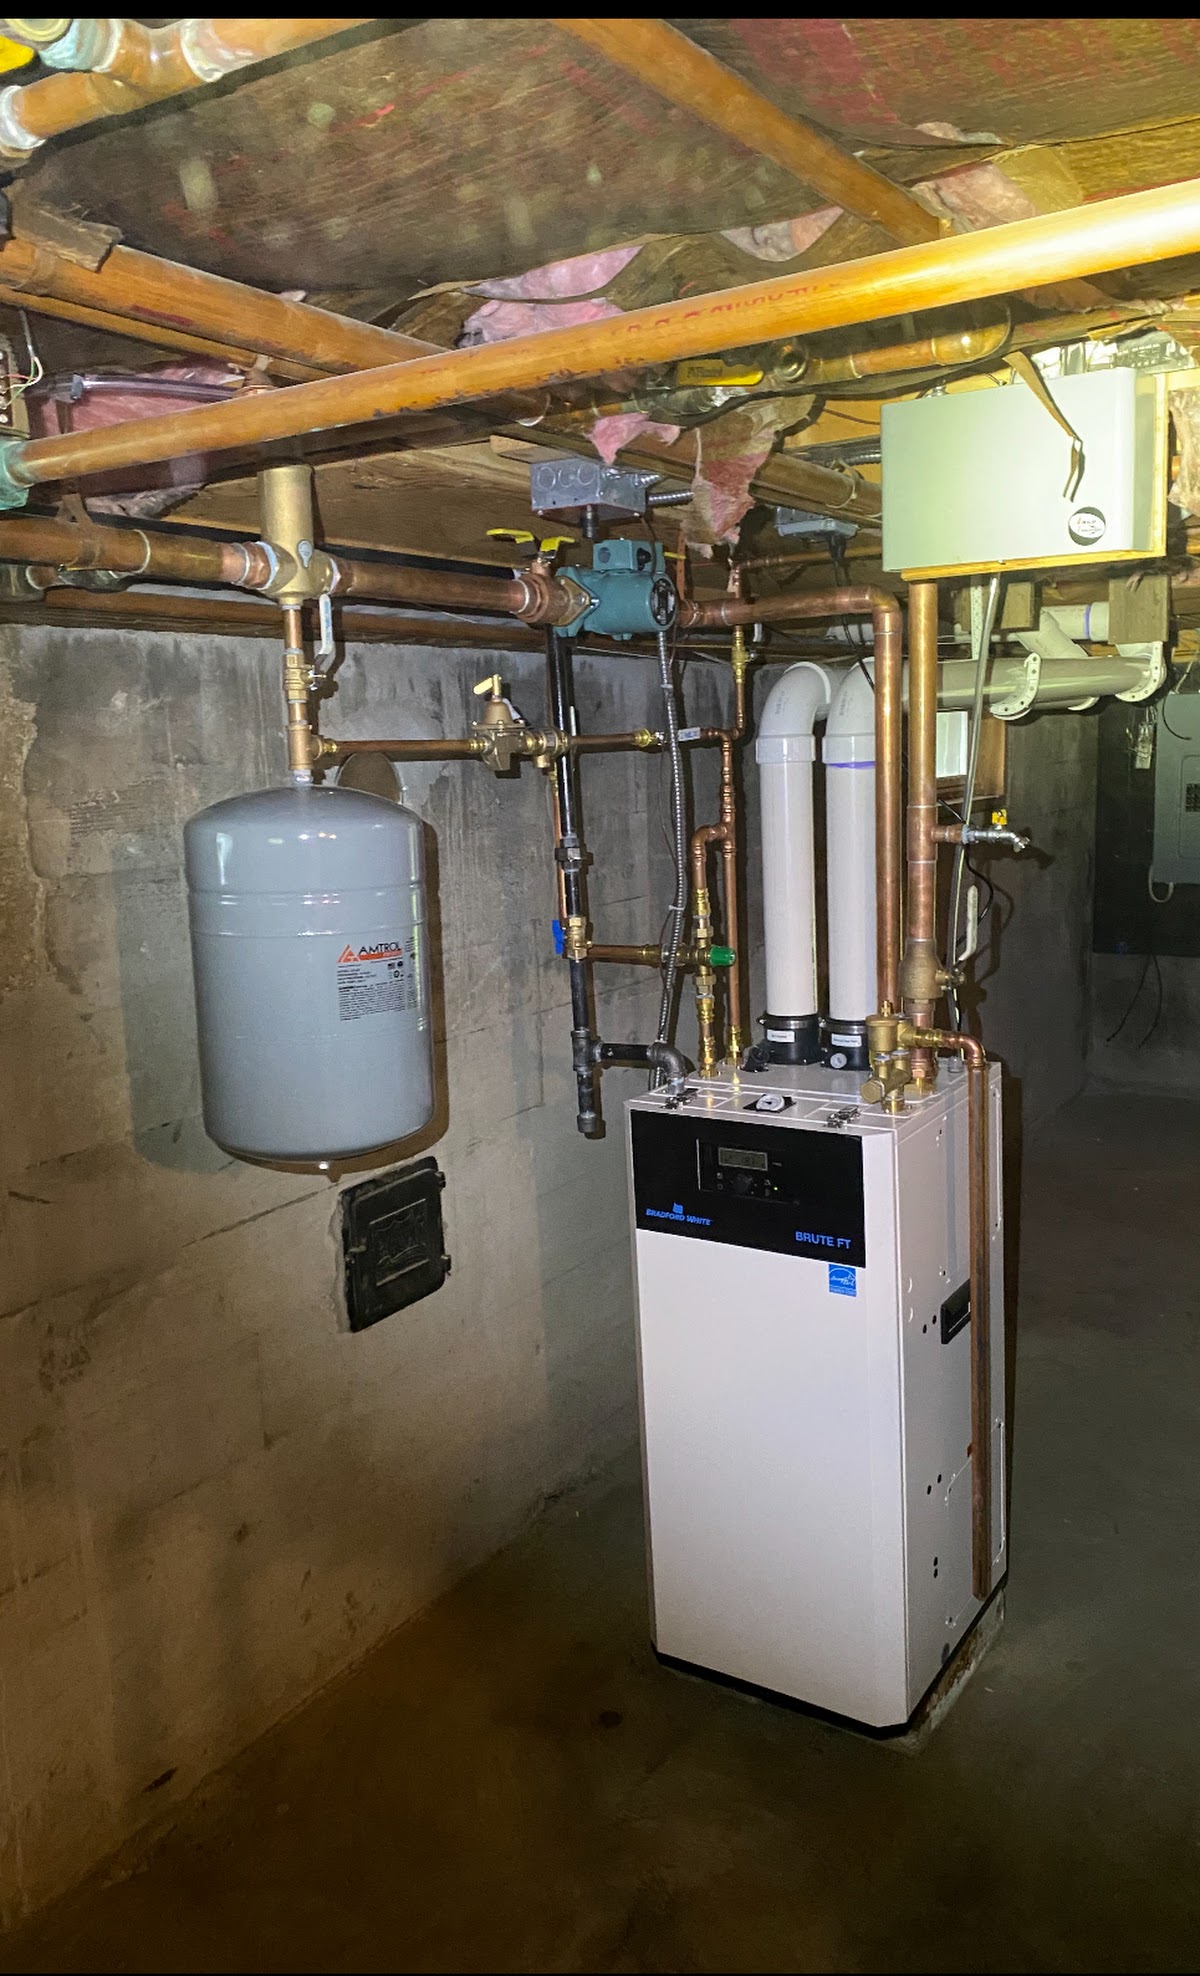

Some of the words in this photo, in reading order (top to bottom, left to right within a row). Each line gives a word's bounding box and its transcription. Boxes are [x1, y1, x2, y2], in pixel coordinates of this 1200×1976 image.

[645, 1208, 685, 1221] BRADFORD
[686, 1215, 711, 1226] WHITE
[795, 1231, 835, 1247] BRUTE
[837, 1238, 851, 1249] FT
